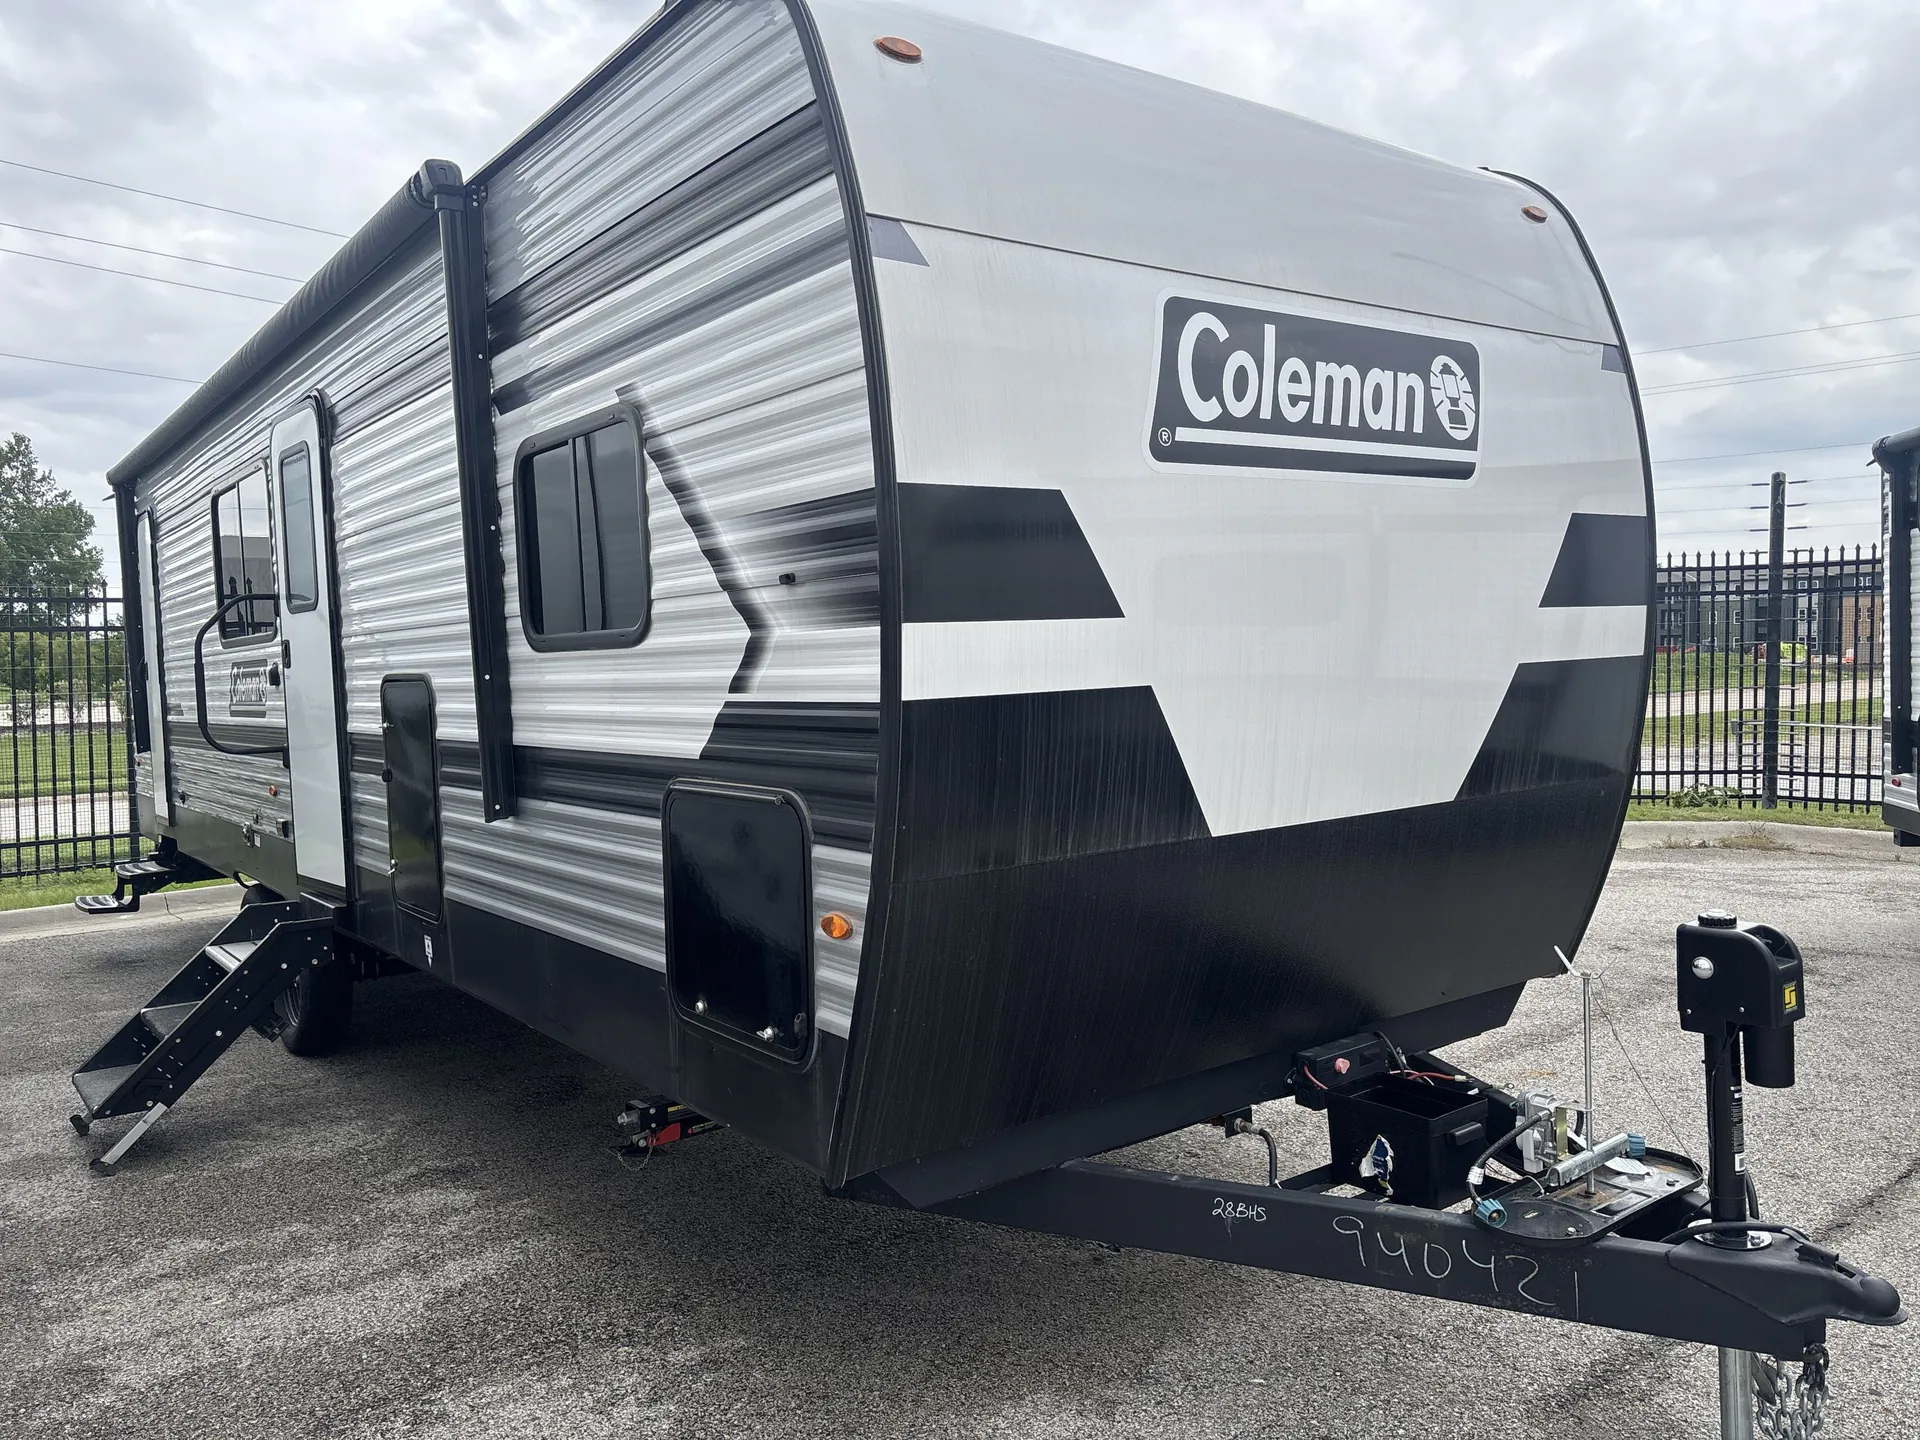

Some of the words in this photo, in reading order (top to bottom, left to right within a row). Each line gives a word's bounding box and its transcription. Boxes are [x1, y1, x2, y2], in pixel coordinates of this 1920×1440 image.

[1177, 311, 1425, 434] Coleman
[231, 665, 260, 704] Coleman
[1211, 1197, 1267, 1222] 28BHS
[1332, 1215, 1580, 1321] 940421
